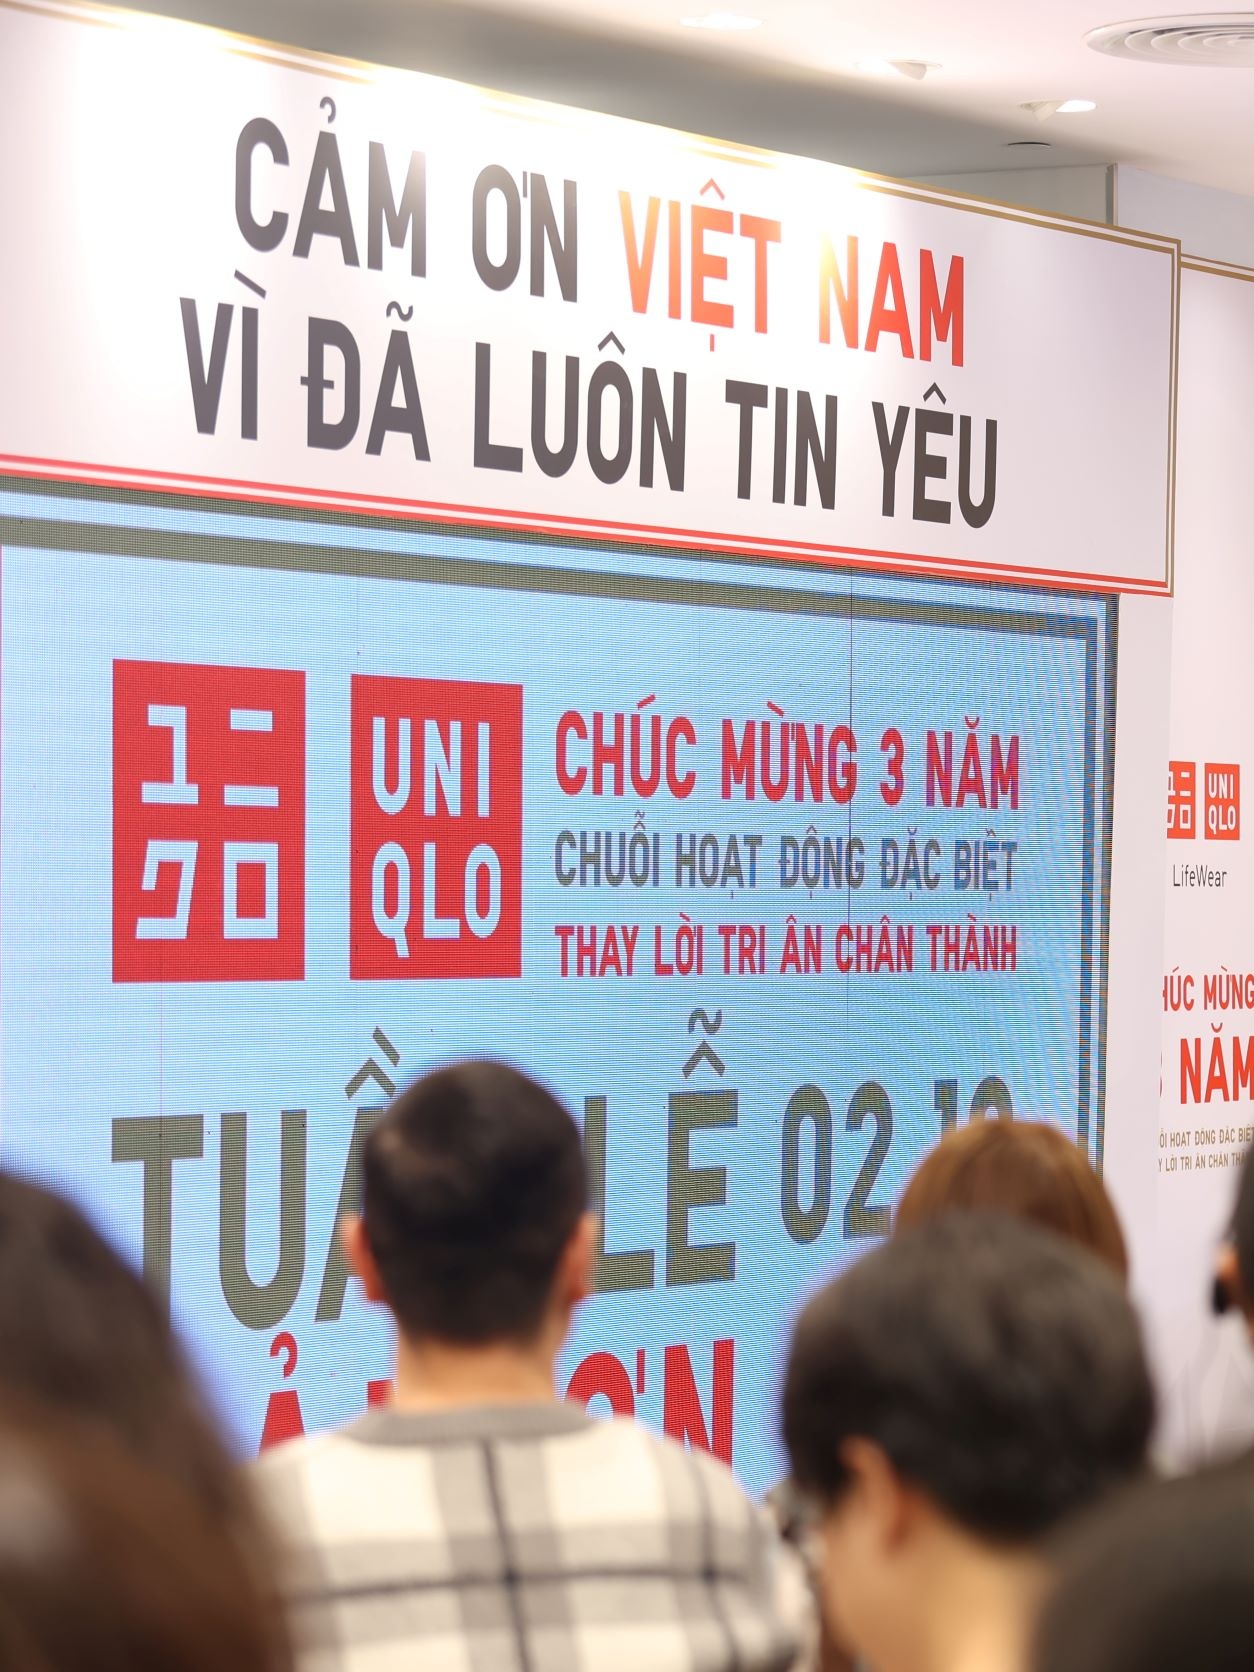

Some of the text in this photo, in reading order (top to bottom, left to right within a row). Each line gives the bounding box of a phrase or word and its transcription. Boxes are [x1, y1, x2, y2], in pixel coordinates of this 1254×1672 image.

[235, 96, 964, 368] CẢM ƠN VIỆT NAM
[180, 269, 997, 529] VÌ ĐÃ LUÔN TIN YÊU
[372, 716, 490, 818] UNI
[556, 694, 1019, 809] CHÚC MỪNG 3 NĂM
[1209, 773, 1233, 799] UNI
[554, 811, 1018, 901] CHUỖI HOẠT ĐỘNG ĐẶC BIỆT
[1208, 804, 1236, 834] QLO
[372, 842, 500, 958] QLO
[1173, 864, 1227, 887] LifeWear
[554, 912, 1017, 977] THAY LỜI TRI ÂN CHÂN THÀNH
[112, 1026, 400, 1330] TUẦ
[584, 1008, 738, 1294] LỄ
[1180, 1156, 1192, 1170] TRI
